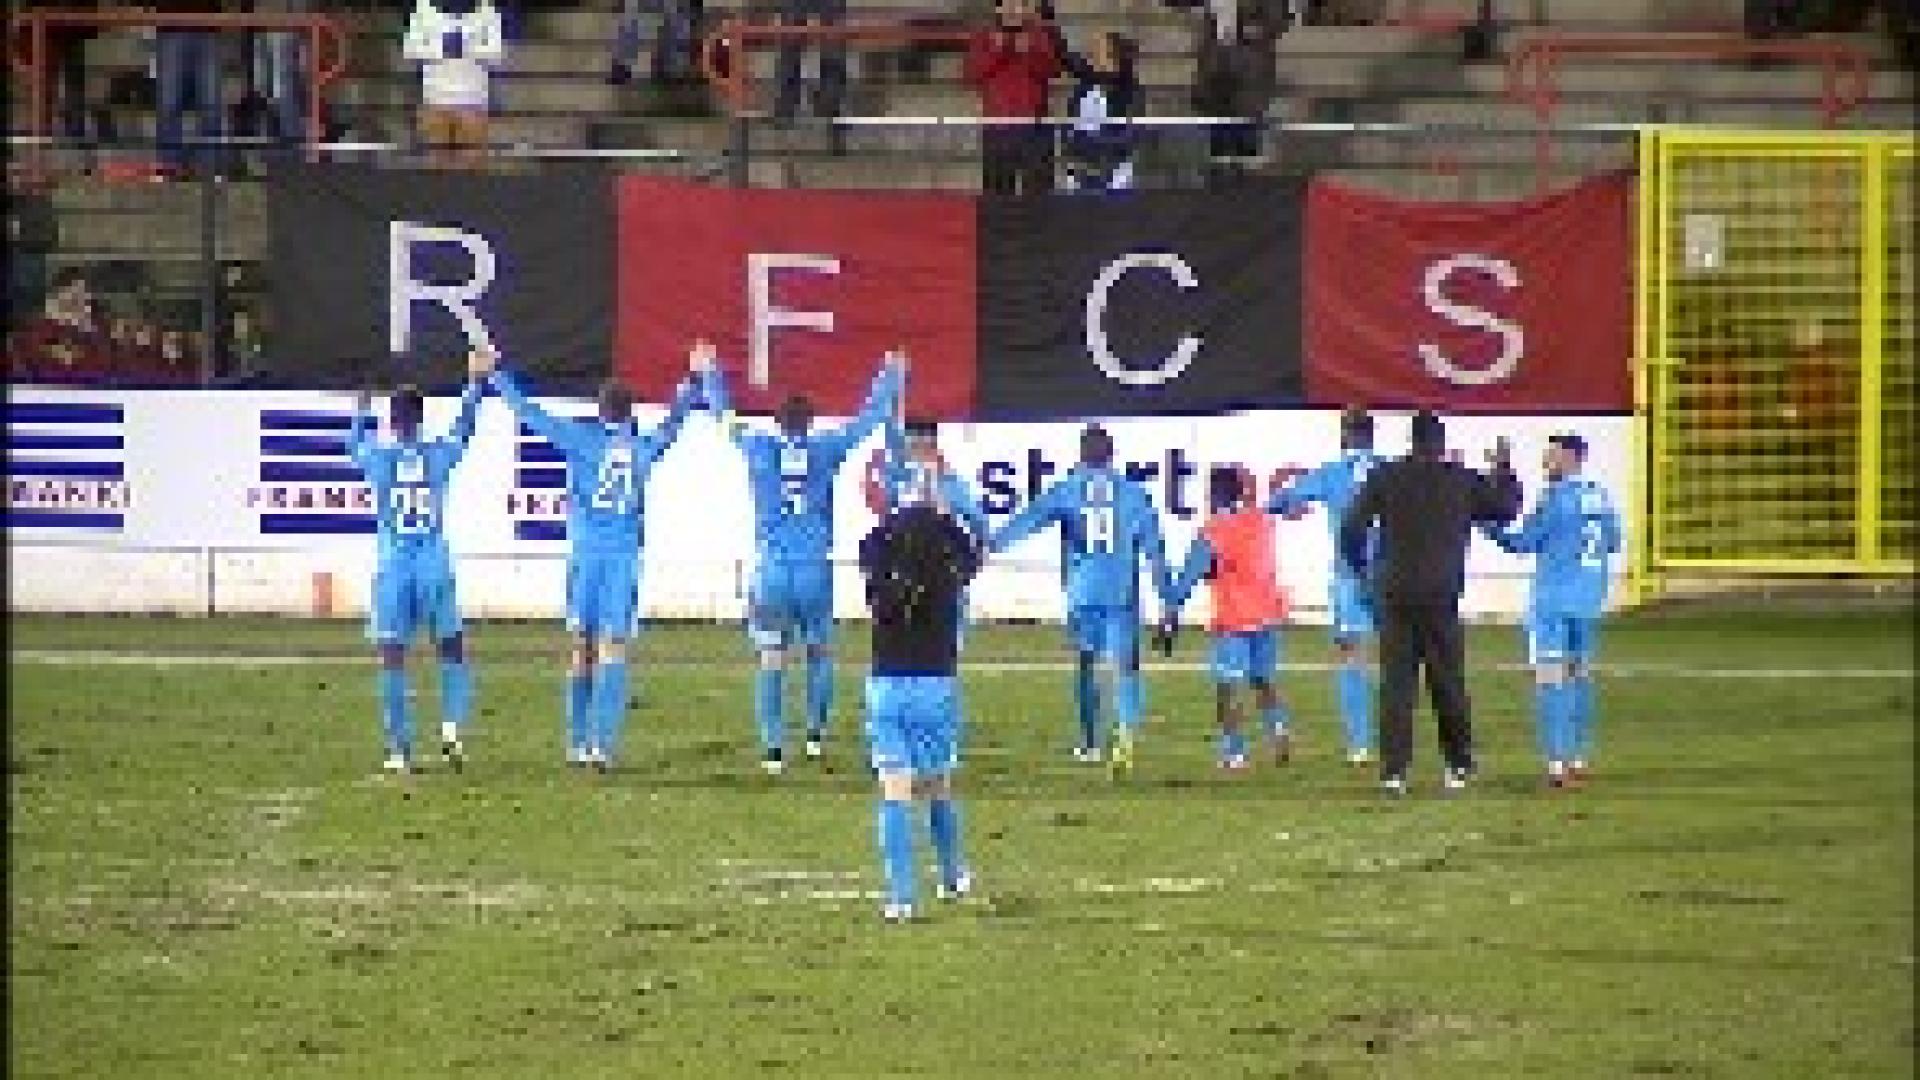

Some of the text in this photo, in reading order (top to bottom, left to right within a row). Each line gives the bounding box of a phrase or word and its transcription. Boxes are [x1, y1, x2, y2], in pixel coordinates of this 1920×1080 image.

[748, 253, 840, 390] F
[1086, 253, 1200, 385] C
[1418, 253, 1524, 385] S
